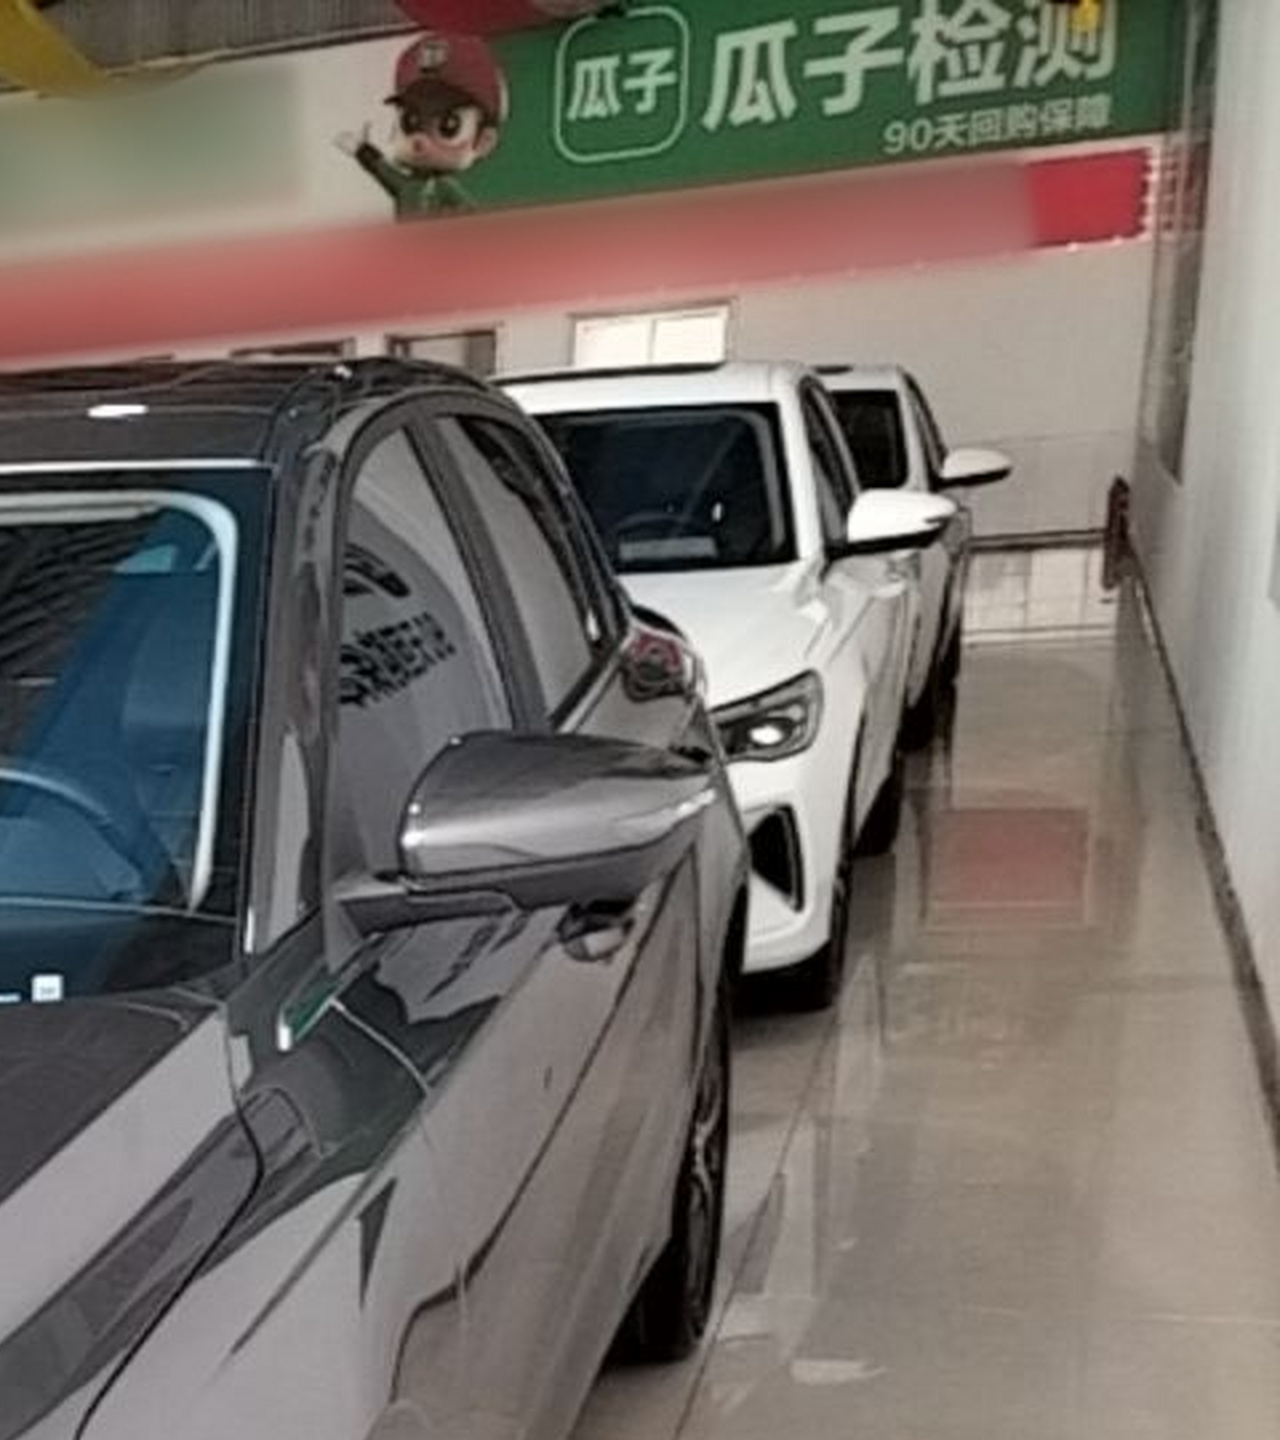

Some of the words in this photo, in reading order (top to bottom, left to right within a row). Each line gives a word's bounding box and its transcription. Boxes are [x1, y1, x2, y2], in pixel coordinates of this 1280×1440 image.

[566, 47, 678, 121] 瓜子
[701, 0, 1118, 131] 瓜子检测
[883, 93, 1112, 155] 90天回购保障
